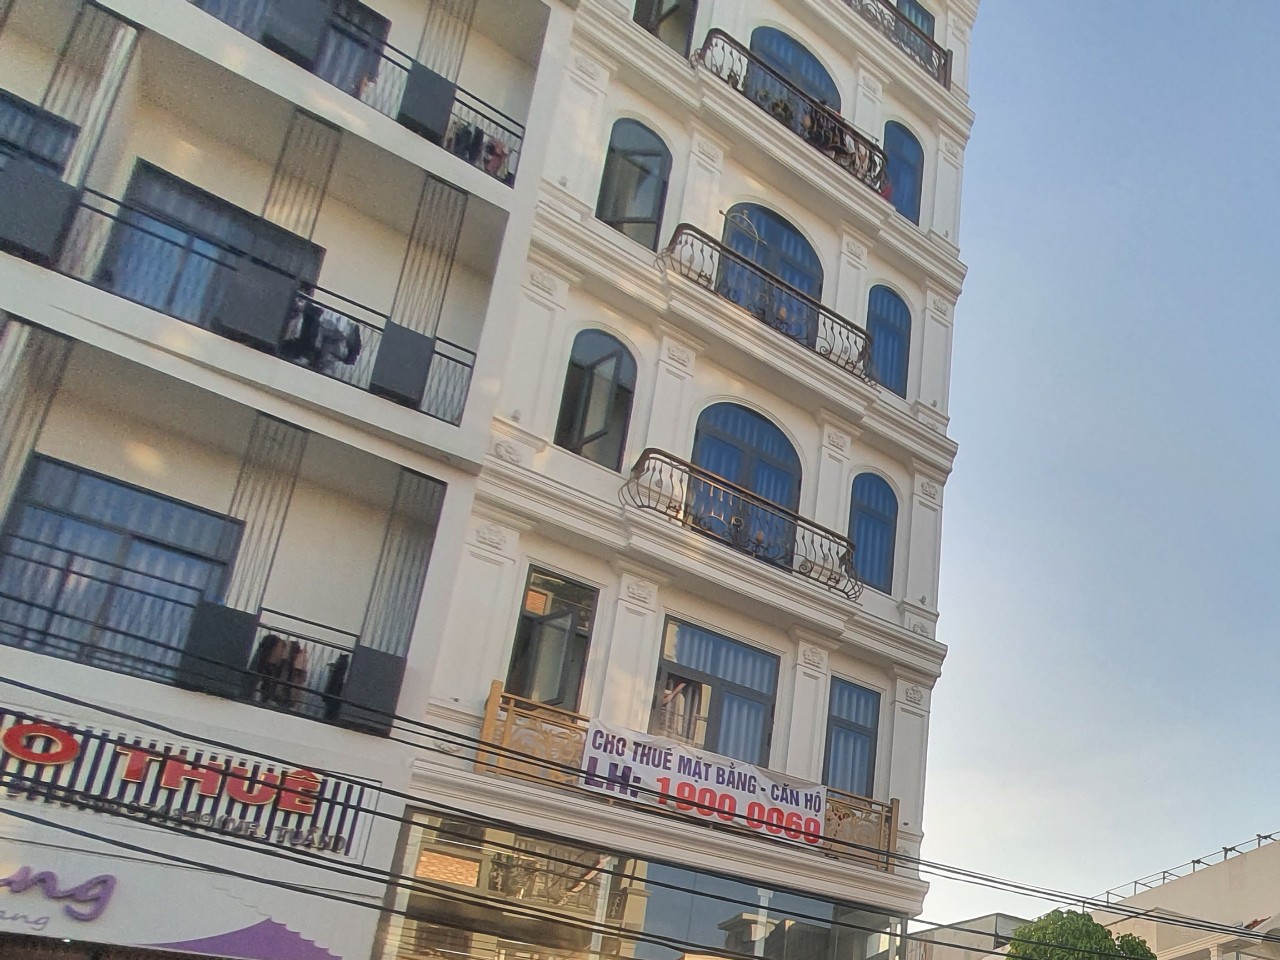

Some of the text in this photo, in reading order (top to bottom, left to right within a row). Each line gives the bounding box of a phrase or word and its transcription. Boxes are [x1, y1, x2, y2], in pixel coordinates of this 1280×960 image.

[116, 745, 321, 815] THUÊ
[583, 756, 641, 798] LH:
[592, 730, 627, 757] CHO
[631, 741, 673, 772] THUÊ
[677, 756, 711, 783] MẶT
[716, 762, 756, 794] BẰNG
[771, 784, 799, 806] CĂN
[804, 792, 822, 817] HỘ
